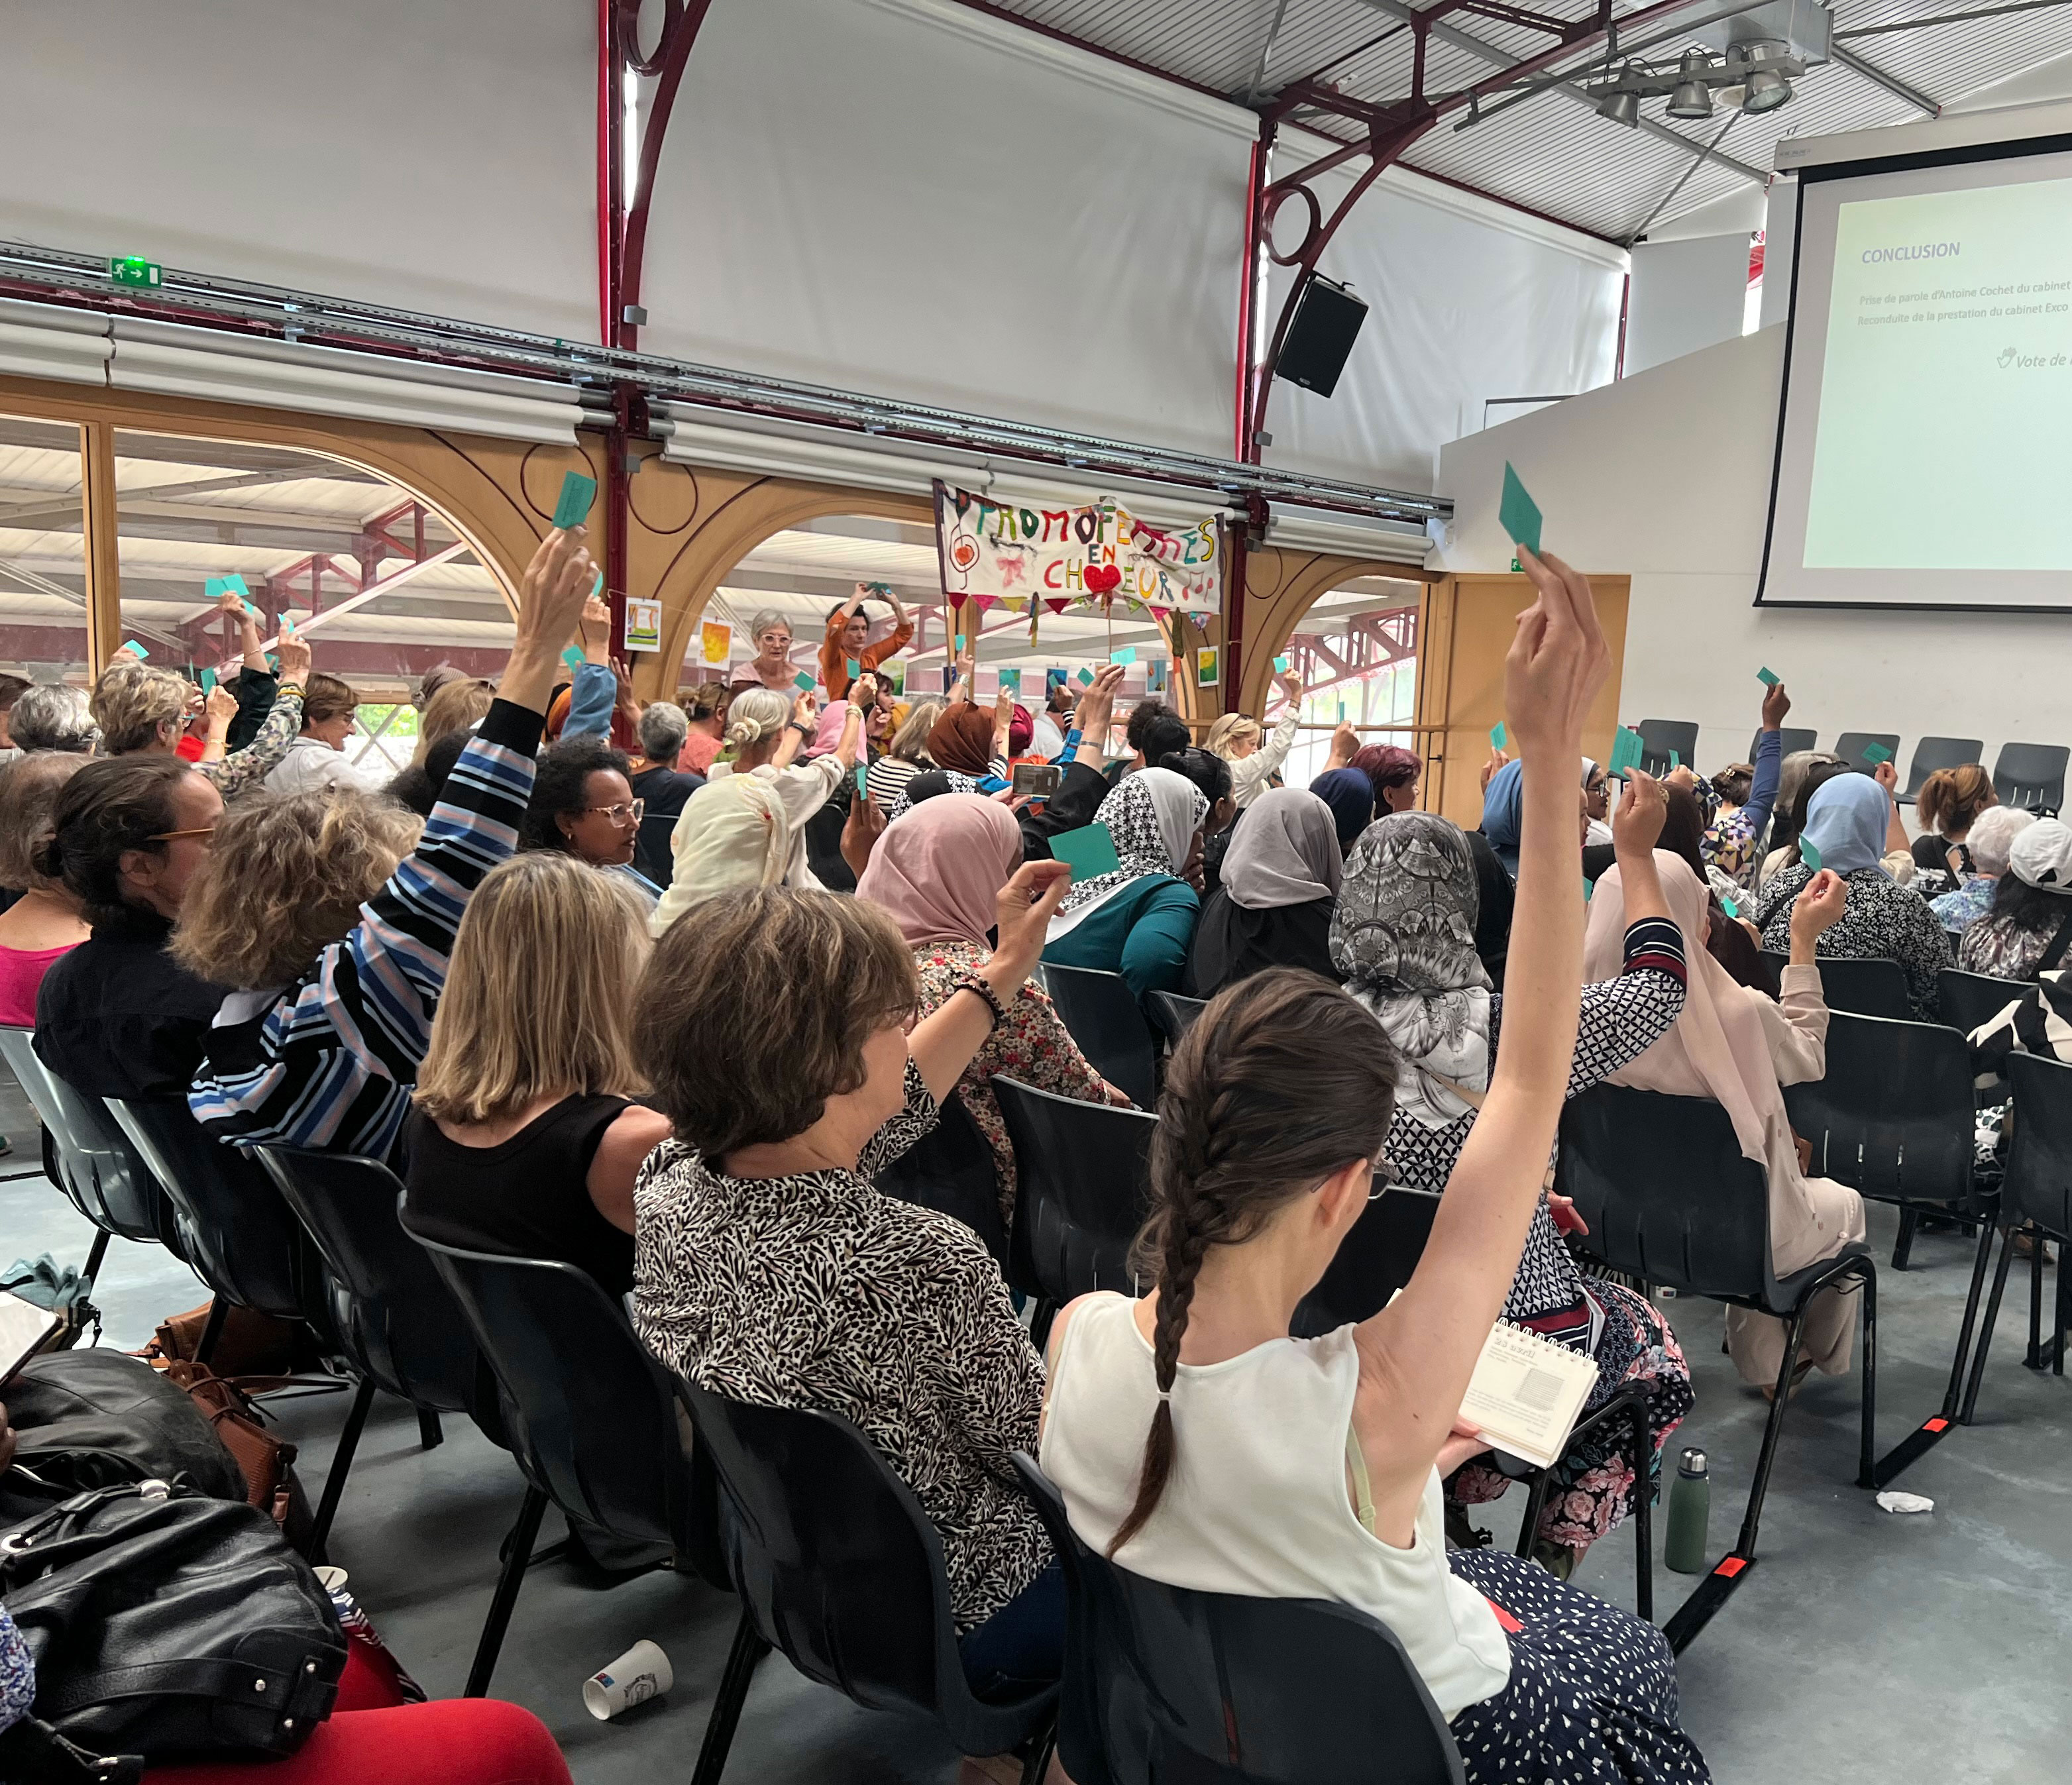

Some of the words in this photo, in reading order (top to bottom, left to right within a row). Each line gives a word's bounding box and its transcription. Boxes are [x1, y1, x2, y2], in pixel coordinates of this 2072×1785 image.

[1862, 242, 1961, 264] CONCLUSION
[1859, 296, 1882, 305] Prise
[1884, 294, 1896, 303] de
[1898, 292, 1929, 305] parole
[1931, 288, 1977, 300] d'Antoine
[1979, 284, 2014, 296] Cochet
[2016, 283, 2030, 294] du
[2032, 280, 2071, 292] cabinet
[1857, 315, 1910, 326] Reconduite
[1912, 312, 1924, 322] de
[1926, 311, 1936, 321] la
[1937, 308, 1987, 323] prestation
[1989, 306, 2002, 316] du
[2005, 304, 2042, 315] cabinet
[2045, 302, 2069, 313] Exco
[2016, 354, 2046, 368] Vote
[2049, 352, 2067, 366] de
[1089, 544, 1115, 564] EN
